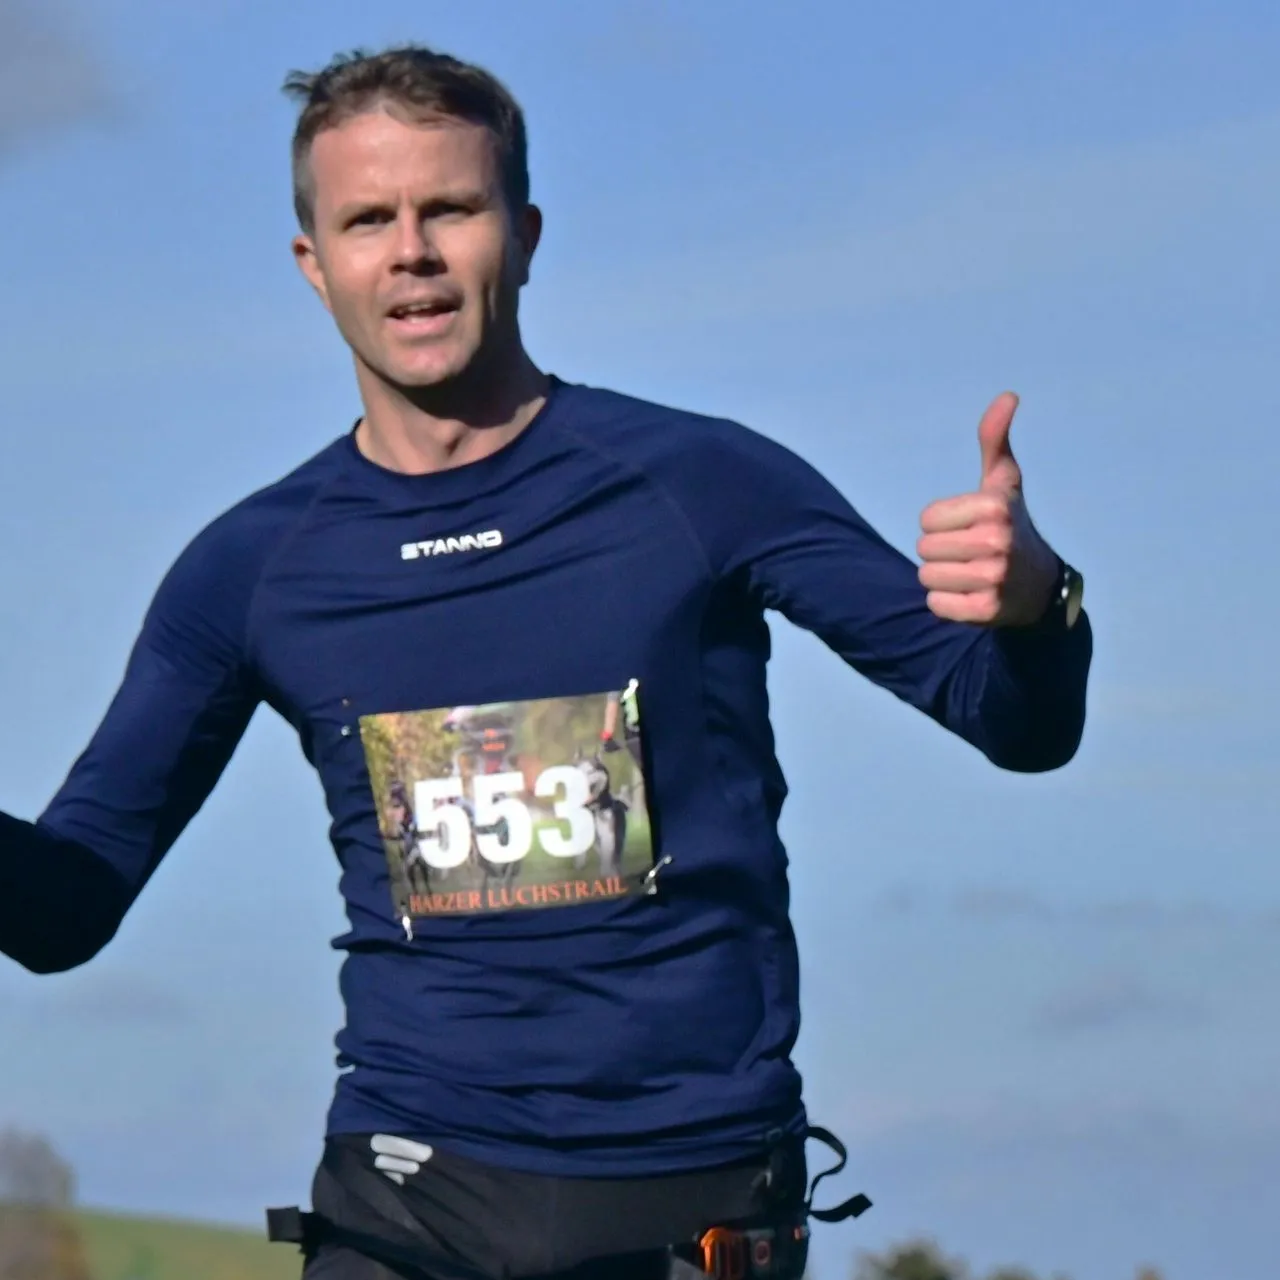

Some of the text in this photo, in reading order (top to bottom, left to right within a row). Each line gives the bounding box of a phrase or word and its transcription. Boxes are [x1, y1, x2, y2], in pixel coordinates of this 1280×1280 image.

[401, 529, 502, 560] STANNO
[414, 765, 595, 868] 553
[409, 877, 628, 913] HARZER LUCHSTRAIL
